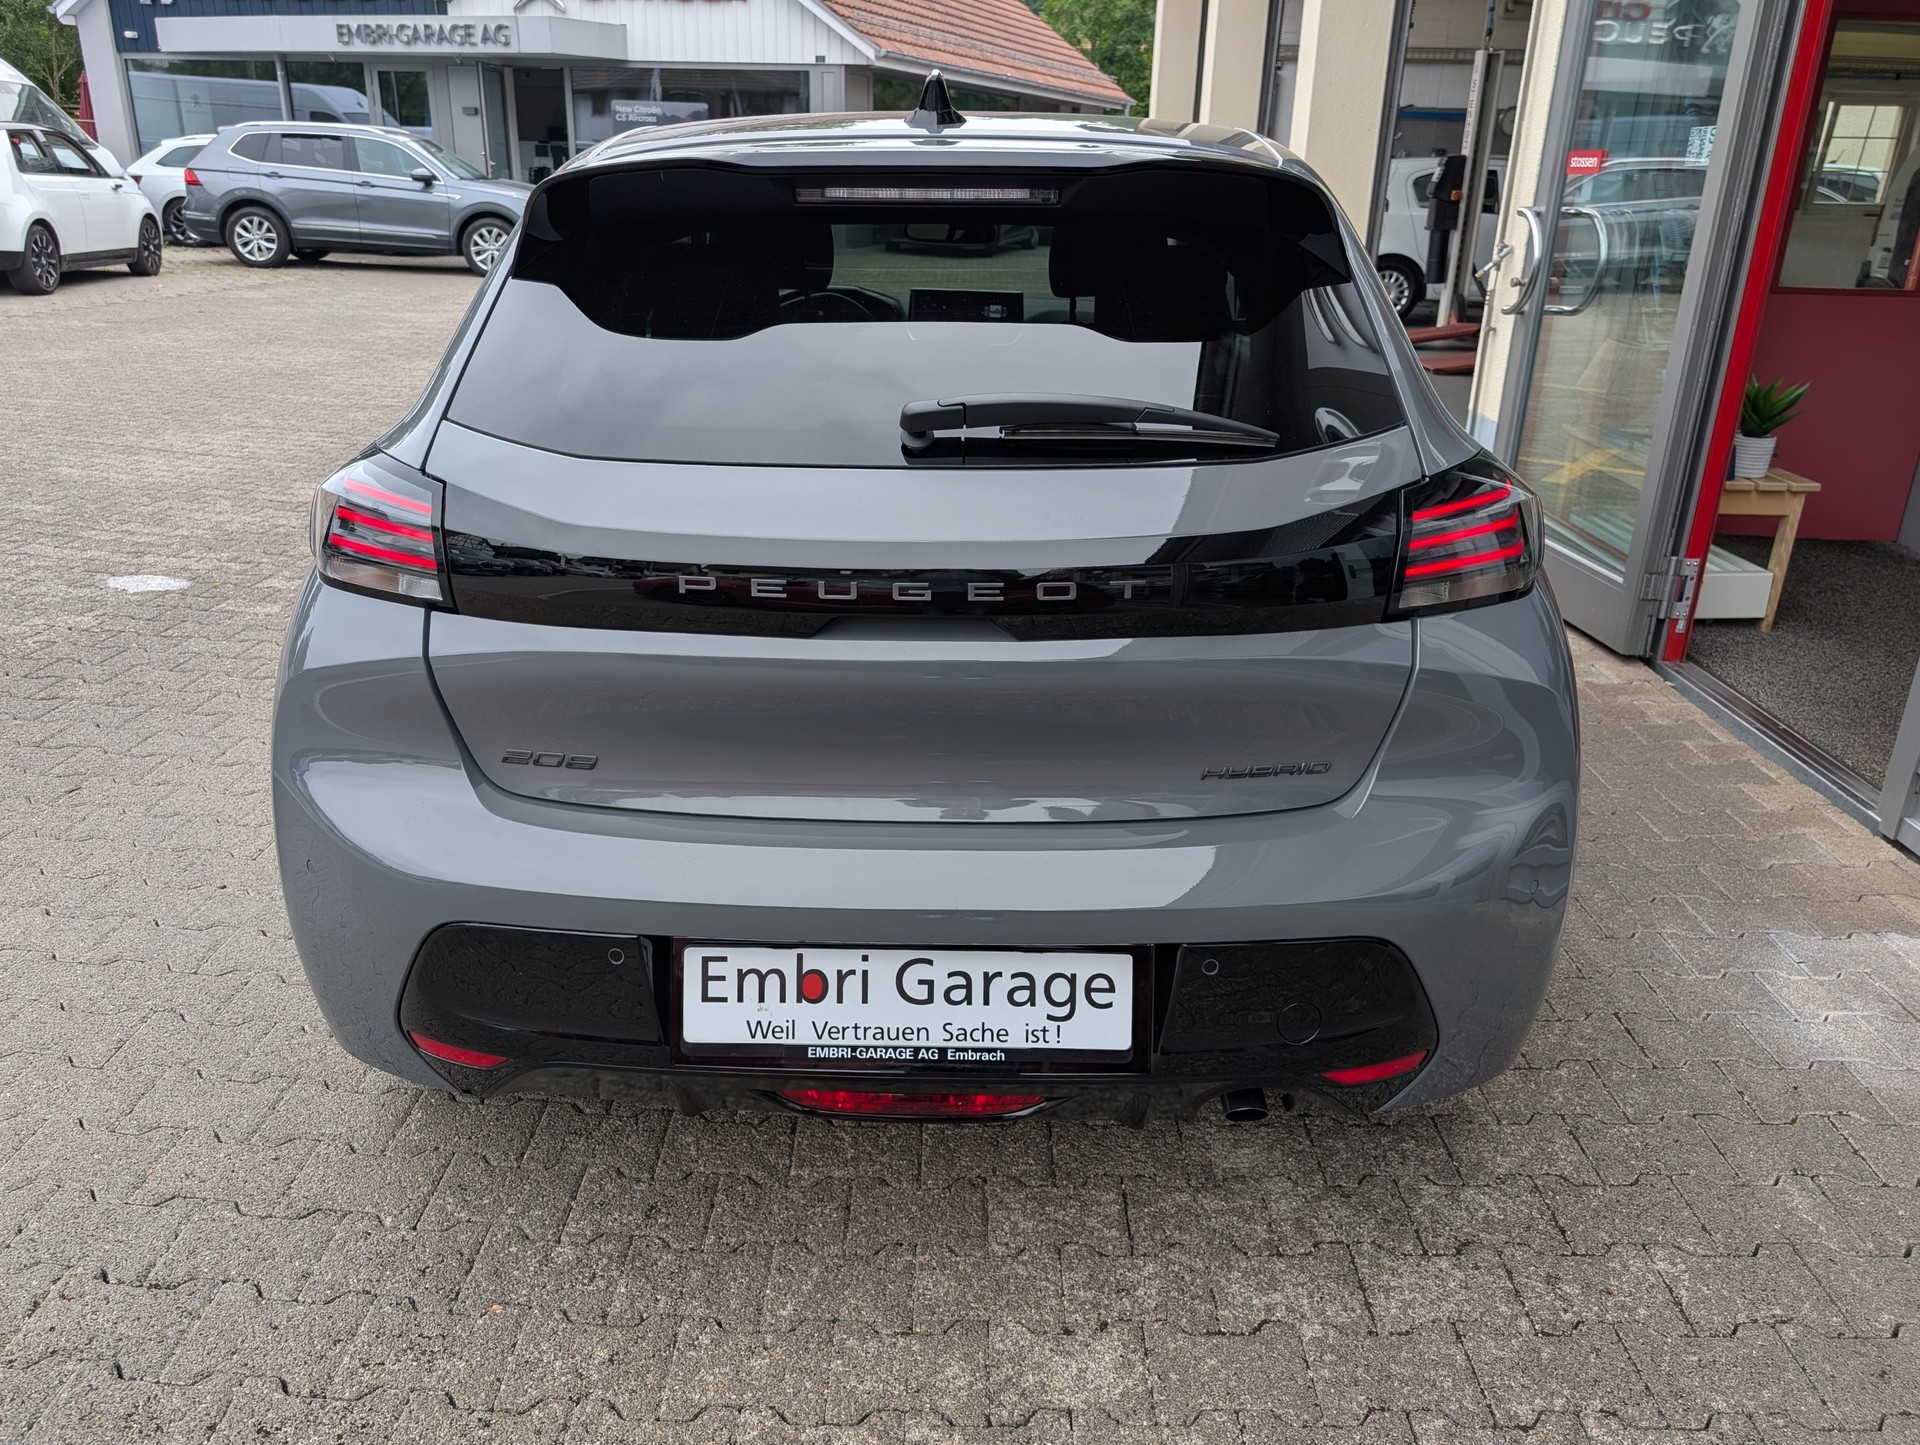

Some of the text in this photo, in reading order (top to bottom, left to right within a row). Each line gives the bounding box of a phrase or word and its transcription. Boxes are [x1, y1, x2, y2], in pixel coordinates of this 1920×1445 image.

[336, 23, 512, 47] EMBRI-GARAGE AG
[615, 104, 632, 113] New
[628, 114, 658, 123] Aircross
[1569, 156, 1598, 168] stossen
[678, 575, 1148, 602] PEUGEOT
[501, 748, 599, 770] 208
[1200, 760, 1333, 780] HYBRID
[700, 953, 1117, 1022] Embri Garage
[746, 1019, 796, 1040] Weil
[811, 1021, 930, 1042] Vertrauen
[942, 1022, 1009, 1043] Sache
[807, 1046, 1005, 1062] EMBRI-GARAGE AG Embrach
